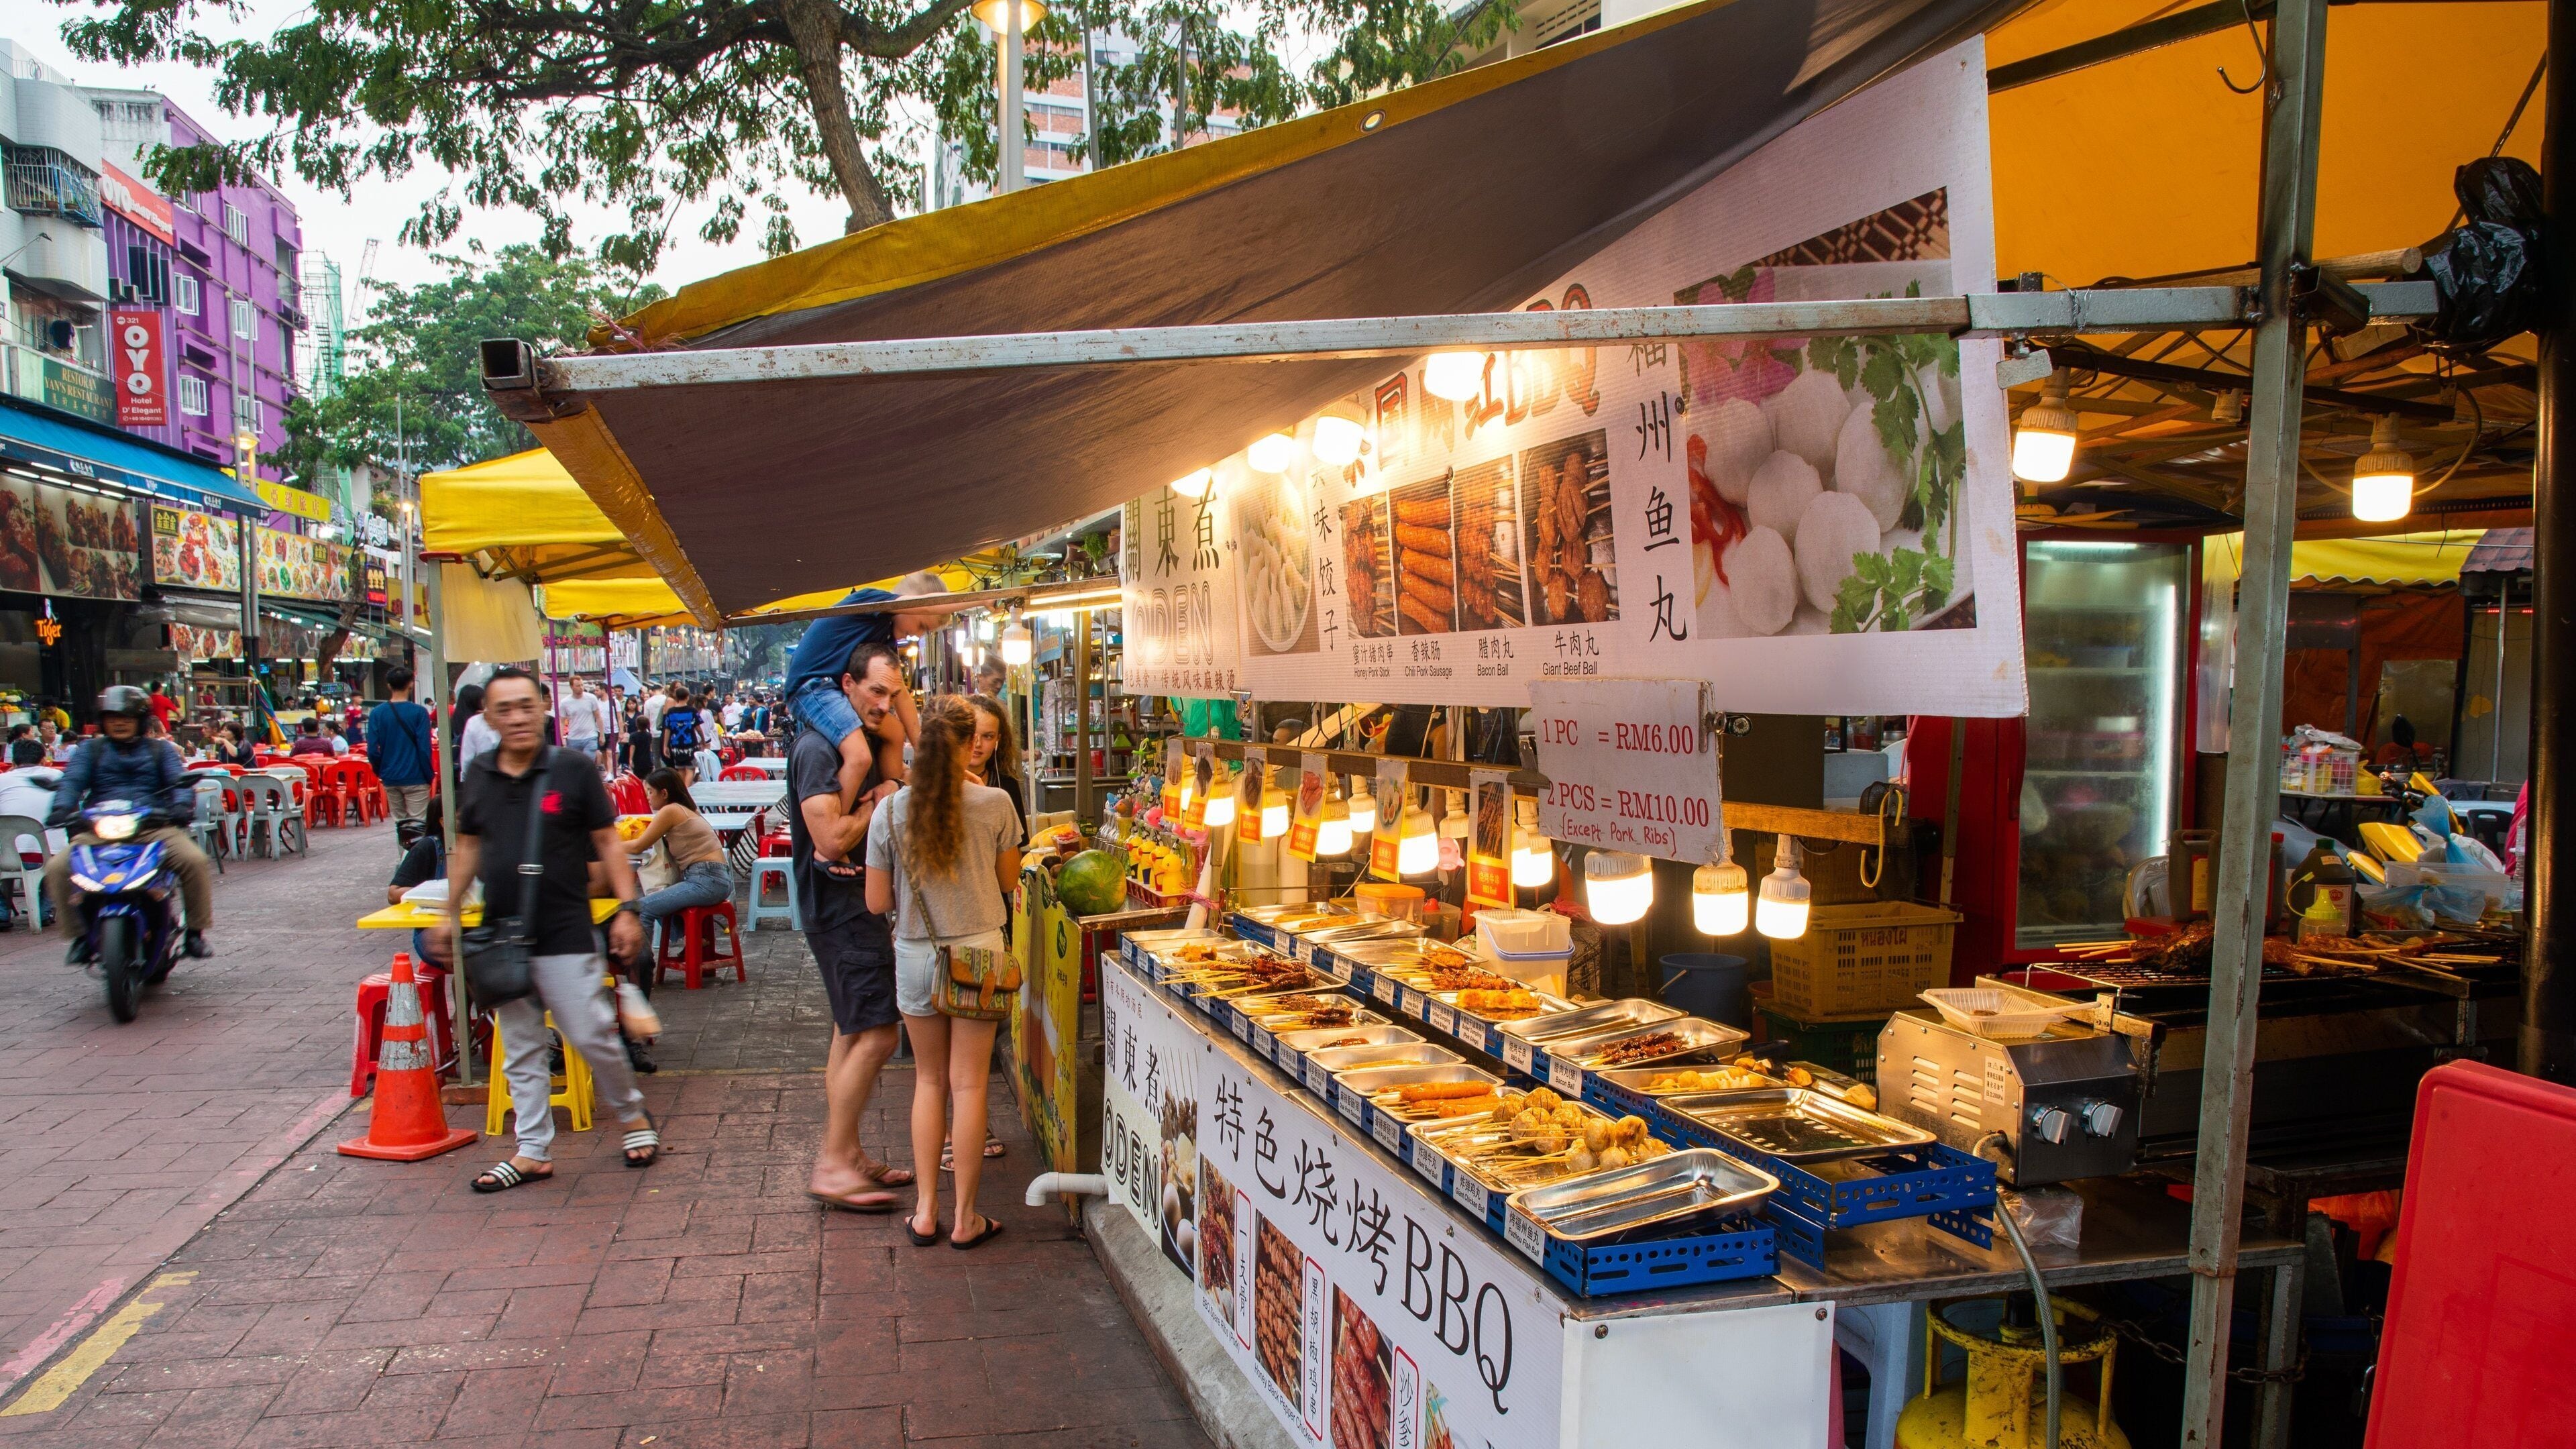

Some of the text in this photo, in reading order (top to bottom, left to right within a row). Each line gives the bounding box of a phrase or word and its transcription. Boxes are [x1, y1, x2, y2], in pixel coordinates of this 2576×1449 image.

[124, 325, 152, 395] OYO
[62, 368, 97, 390] RESTORAN
[44, 376, 113, 410] YAN'S RESTAURANT
[131, 407, 161, 415] Elegant
[36, 619, 62, 646] Tiger
[1132, 581, 1214, 666] ODEN
[1352, 641, 1393, 665] 蜜汁猪肉串
[1411, 639, 1441, 662] 香辣肠
[1478, 634, 1514, 660] 腊肉丸
[1554, 629, 1599, 659] 牛肉丸
[1354, 666, 1391, 678] Honey Pork Stick
[1417, 665, 1429, 677] Pork
[1429, 665, 1452, 679] Sausage
[1477, 663, 1509, 676] Bacon Ball
[1542, 661, 1598, 676] Giant Beef Ball
[1554, 719, 1578, 745] PC
[1615, 722, 1694, 755] RM6.00
[1558, 782, 1595, 812] PCS
[1617, 790, 1709, 828] RM10.00
[1562, 812, 1678, 858] (Except Pork Ribs)
[1105, 1004, 1161, 1123] 關東煮
[1555, 1075, 1567, 1087] Bacon
[1350, 1110, 1360, 1122] Sausage
[1387, 1136, 1398, 1151] Sausage
[1418, 1144, 1437, 1169] 炸弹牛丸
[1104, 1097, 1159, 1230] ODEN
[1416, 1159, 1425, 1168] Giant
[1455, 1187, 1464, 1199] Giant
[1464, 1193, 1478, 1209] Chicken
[1460, 1174, 1481, 1200] 炸弹鸡丸
[1509, 1210, 1540, 1246] 烤福州鱼丸
[1508, 1228, 1540, 1257] Fuzhou Fish Ball
[1238, 1229, 1248, 1317] 一支骨
[1202, 1296, 1240, 1354] BBQ Spare Ribs (Pork)
[1309, 1277, 1320, 1420] 黑胡椒鸡串
[1254, 1362, 1315, 1447] Honey Black Pepper Chicken
